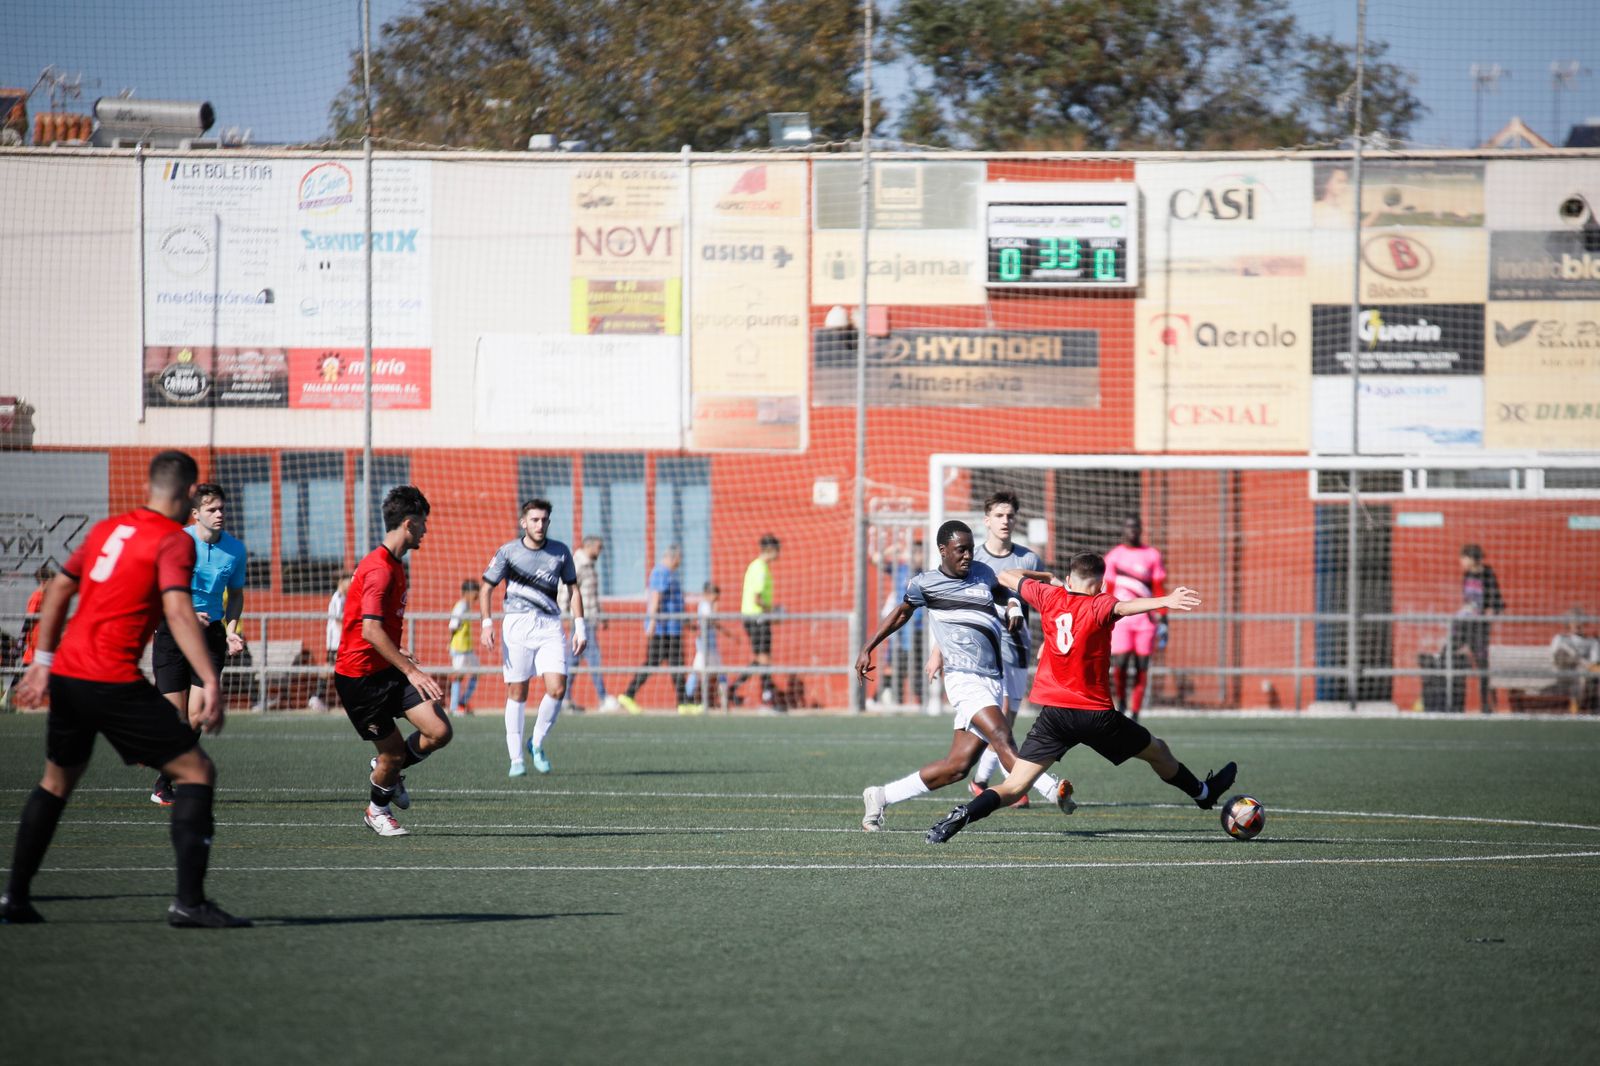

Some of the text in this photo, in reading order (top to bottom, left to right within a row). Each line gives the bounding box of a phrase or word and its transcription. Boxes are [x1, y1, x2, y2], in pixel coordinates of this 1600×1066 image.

[183, 163, 272, 180] LA BOLETINA
[576, 170, 679, 179] JUAN ORTEGA
[1169, 188, 1254, 220] CASI
[575, 226, 673, 258] NOVI
[702, 244, 764, 261] asisa
[867, 253, 975, 282] cajamar
[1000, 248, 1021, 281] 0
[695, 312, 800, 330] grupopuma
[1358, 309, 1442, 343] Guerin
[915, 336, 1063, 361] HYUNDAI
[348, 358, 407, 376] mtrio
[89, 524, 136, 583] 5
[1056, 612, 1074, 655] 8
